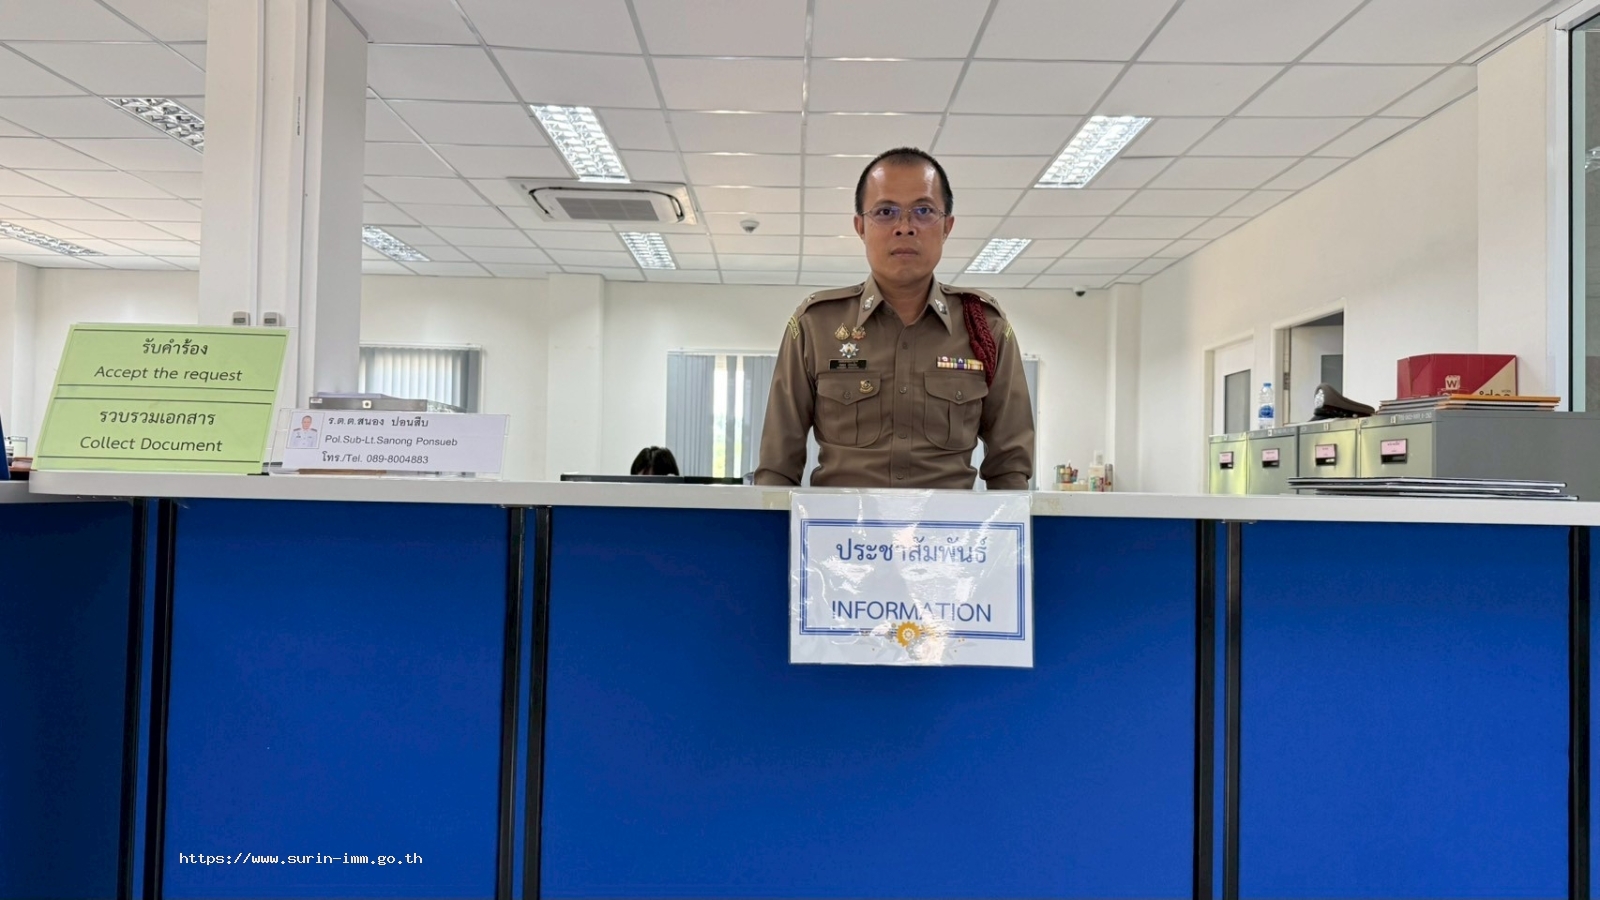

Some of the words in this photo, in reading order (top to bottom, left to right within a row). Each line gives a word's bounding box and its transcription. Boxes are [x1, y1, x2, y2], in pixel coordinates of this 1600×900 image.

[142, 337, 209, 356] รับคำร้อง
[94, 365, 149, 381] Accept
[153, 366, 179, 380] the
[183, 368, 244, 383] request
[99, 409, 217, 426] รวบรวมเอกสาร
[80, 435, 136, 450] Collect
[140, 437, 224, 452] Document
[324, 434, 413, 447] Pol.Sub-Lt.Sanong
[415, 436, 458, 447] Ponsueb
[322, 450, 363, 463] โทร./Tel.
[366, 453, 429, 464] 089-8004883
[835, 535, 988, 563] ประชาสัมพันธ์
[832, 600, 992, 622] INFORMATION
